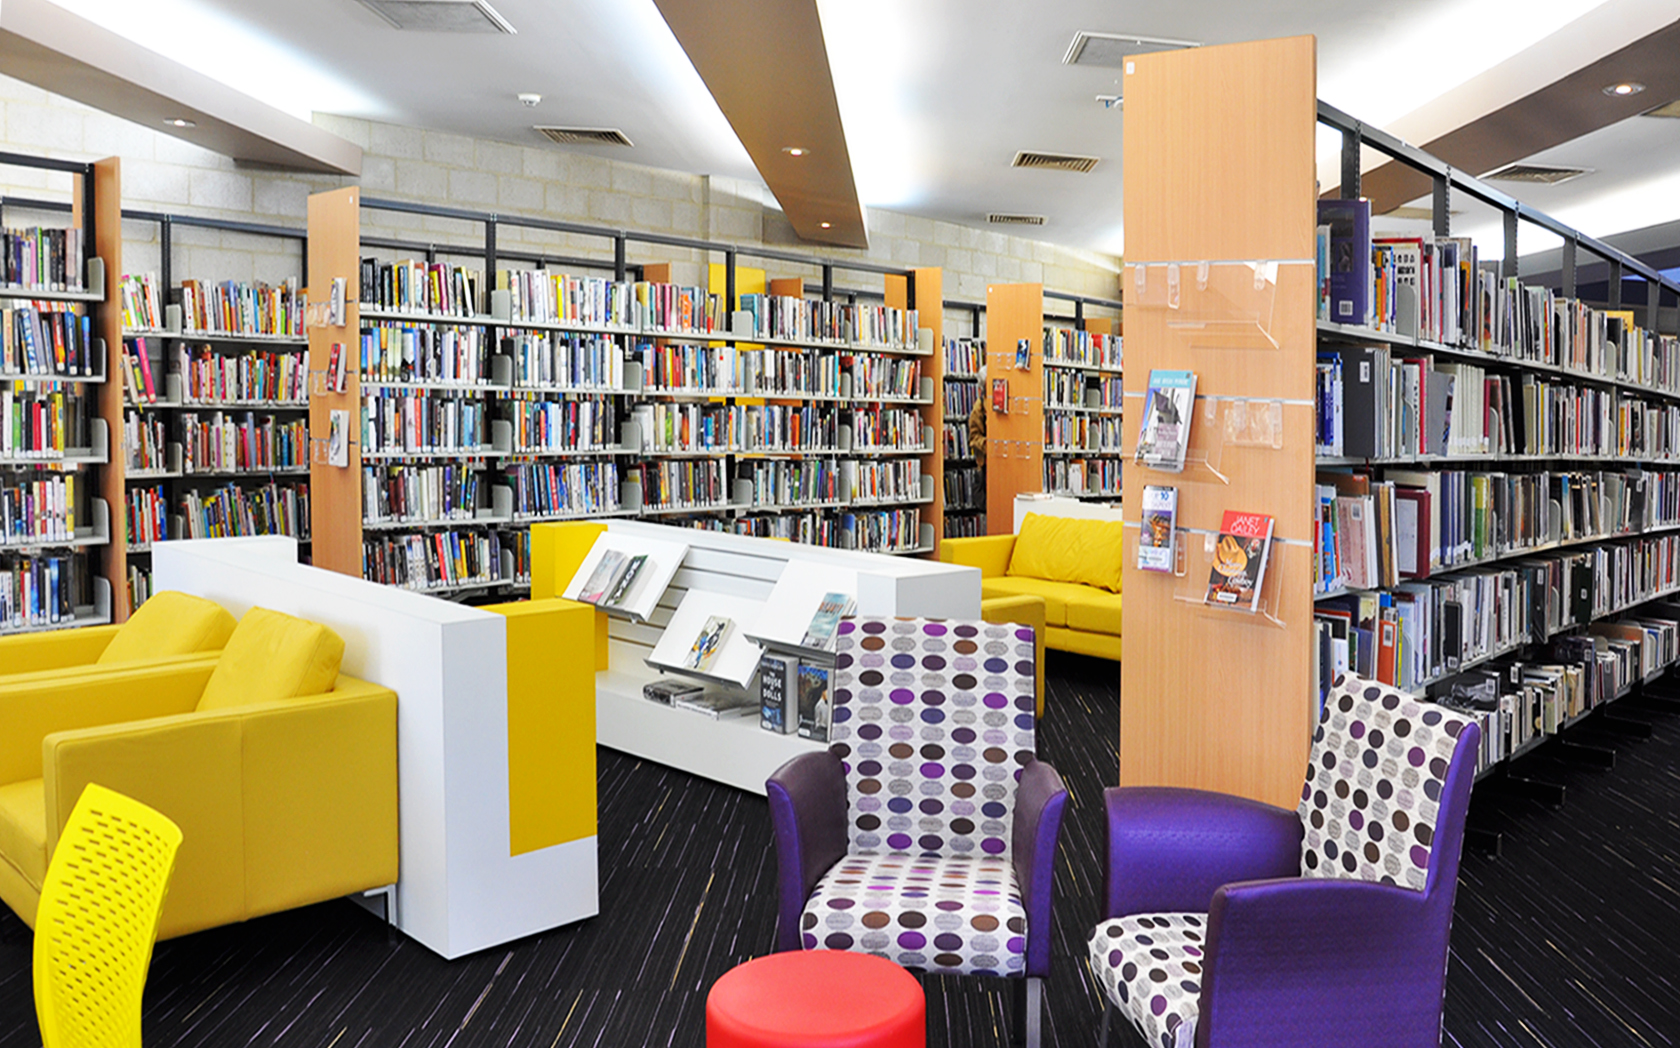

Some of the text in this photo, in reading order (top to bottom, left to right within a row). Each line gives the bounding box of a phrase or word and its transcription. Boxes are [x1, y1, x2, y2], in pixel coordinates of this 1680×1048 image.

[1236, 515, 1260, 526] JANET
[762, 675, 782, 689] HOUSE
[762, 687, 782, 702] DOLLS
